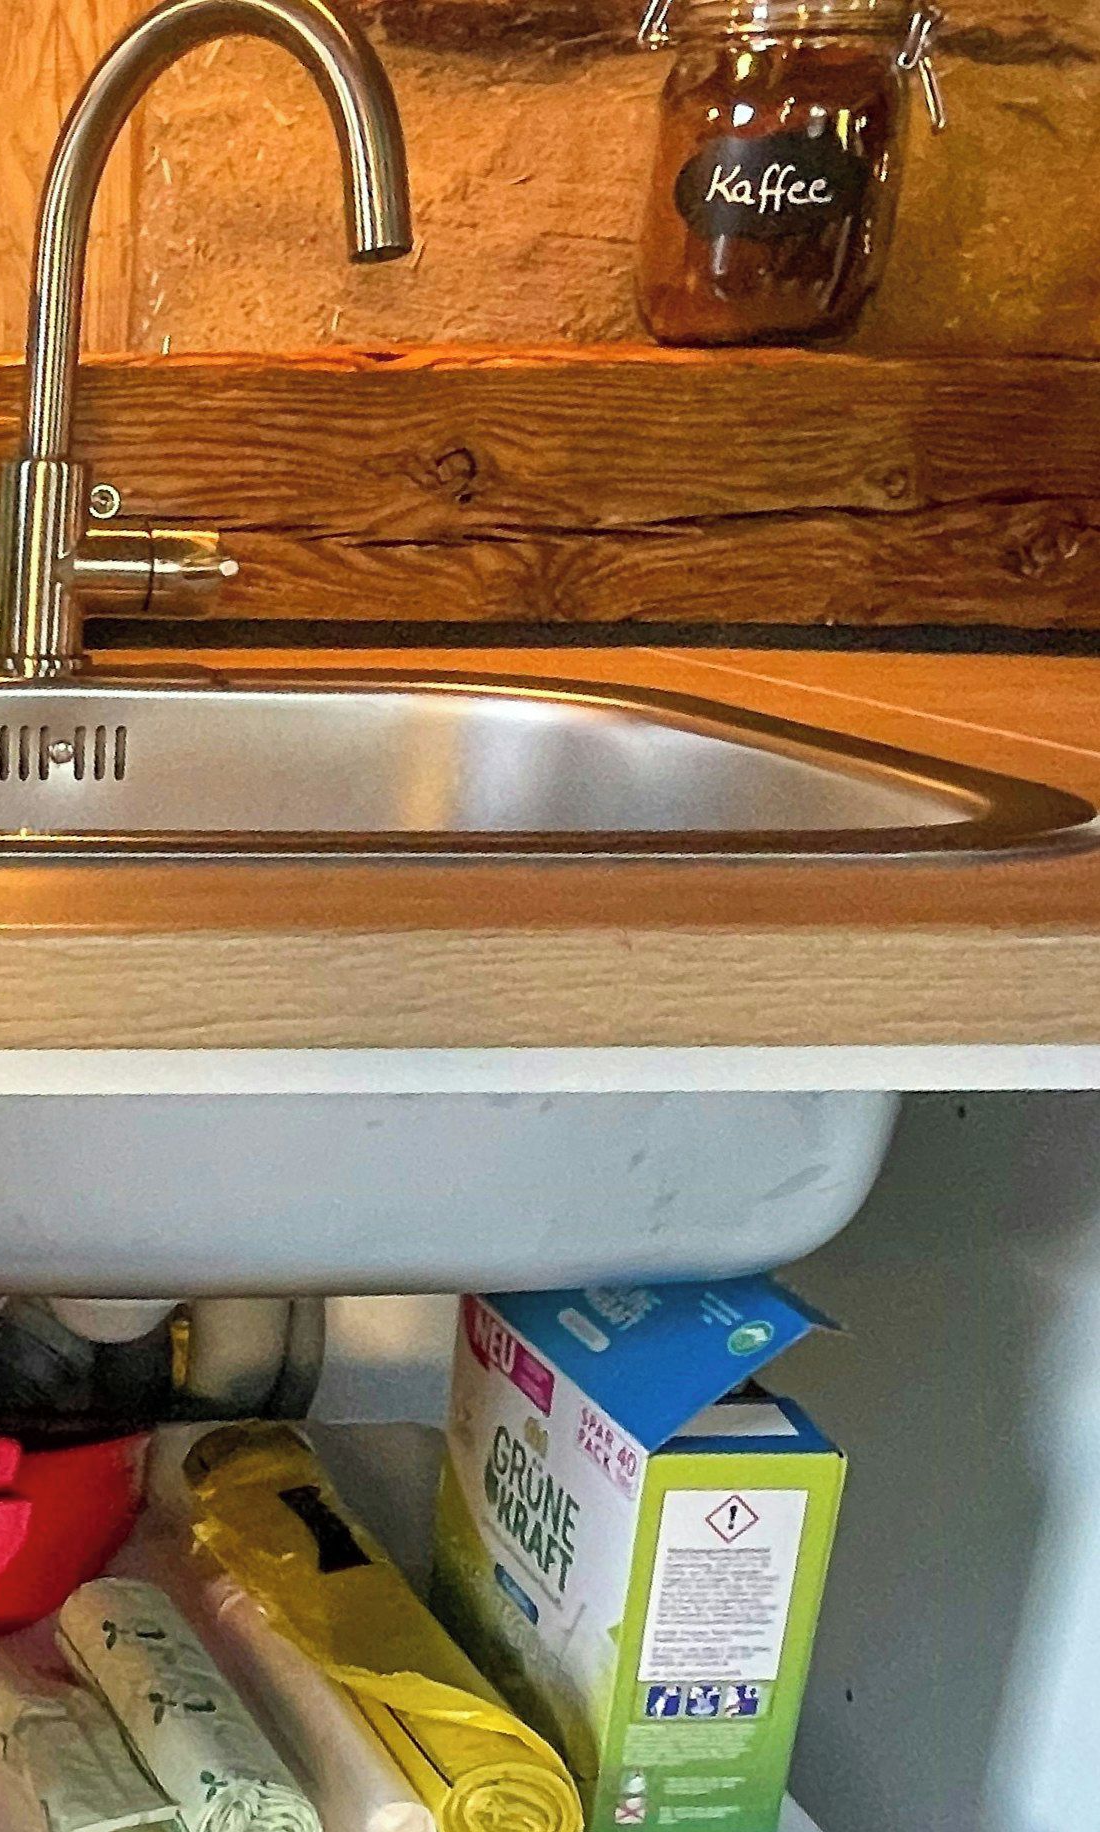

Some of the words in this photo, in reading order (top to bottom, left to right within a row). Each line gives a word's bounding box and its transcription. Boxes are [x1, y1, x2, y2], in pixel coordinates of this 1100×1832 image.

[705, 164, 832, 213] Kaffee
[473, 1308, 517, 1374] NEU
[493, 1425, 580, 1552] GRÜNE
[497, 1484, 573, 1594] KRAFT
